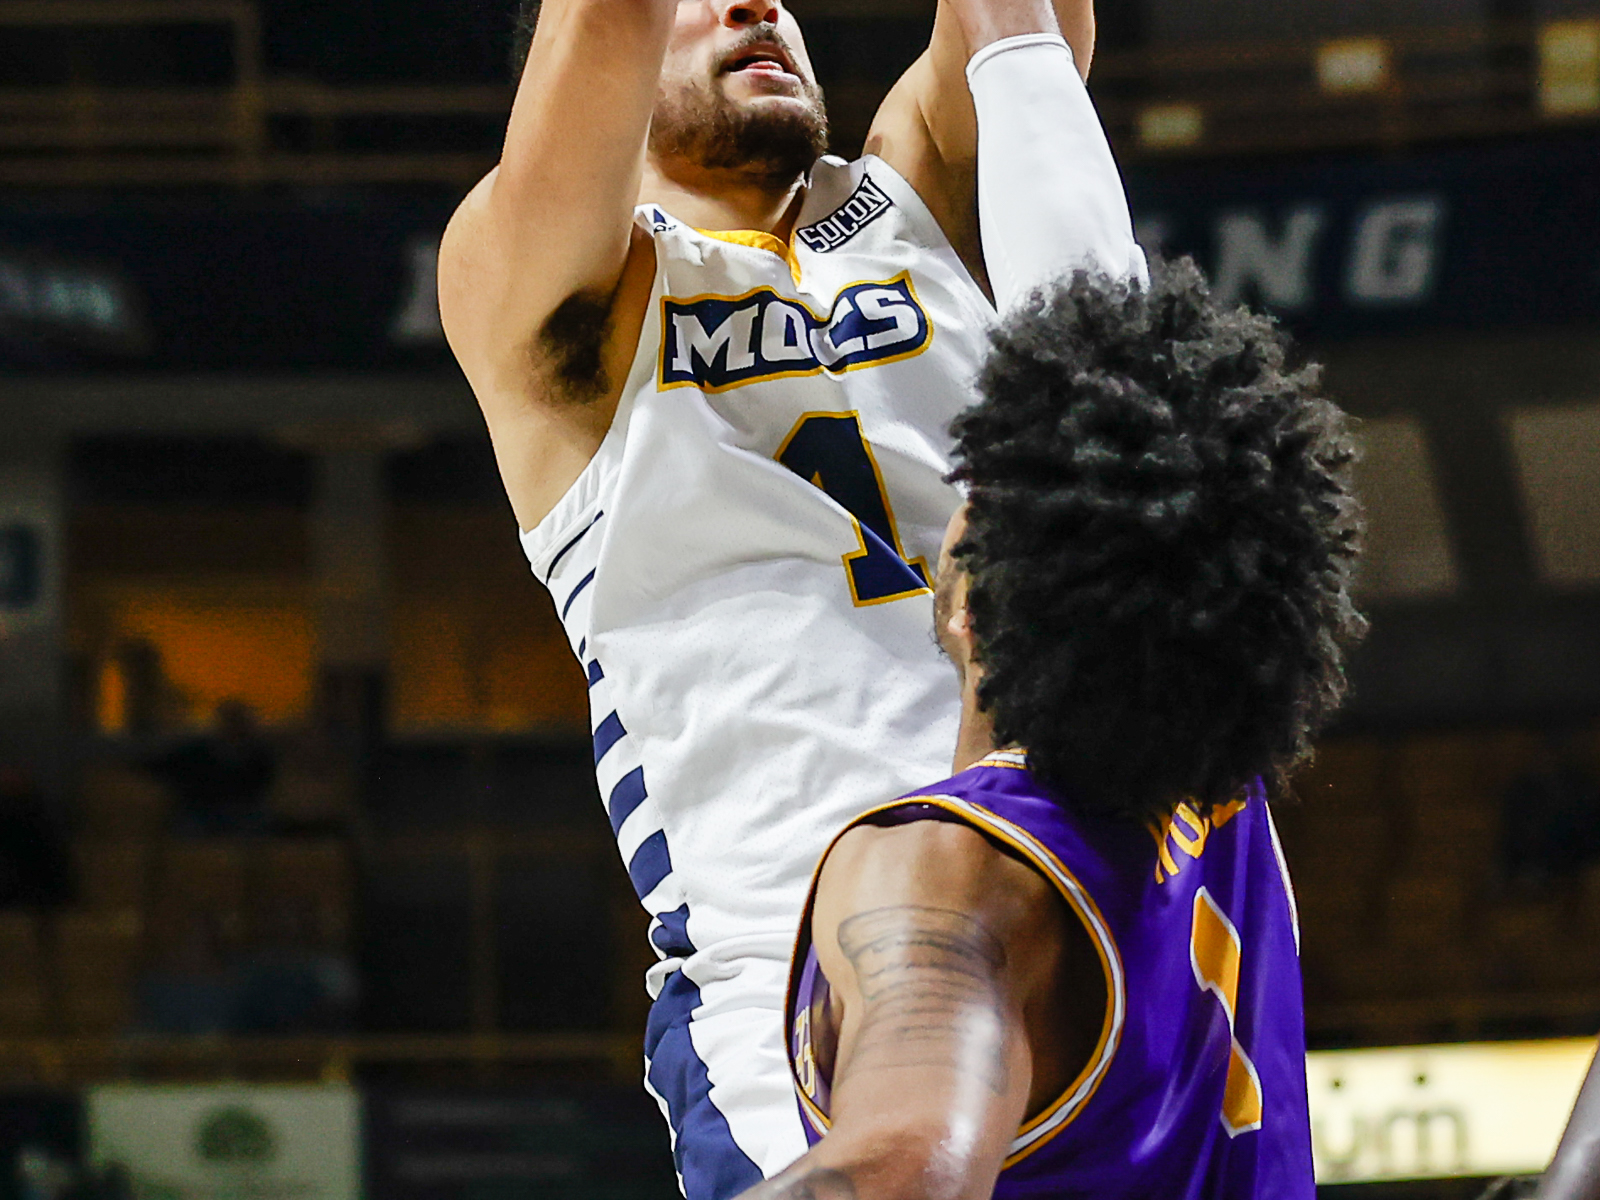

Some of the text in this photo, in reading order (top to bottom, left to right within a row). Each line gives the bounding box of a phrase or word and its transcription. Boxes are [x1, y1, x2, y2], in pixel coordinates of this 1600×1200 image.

[798, 176, 890, 253] SOCON
[672, 289, 919, 373] MOCS
[774, 410, 935, 608] 1
